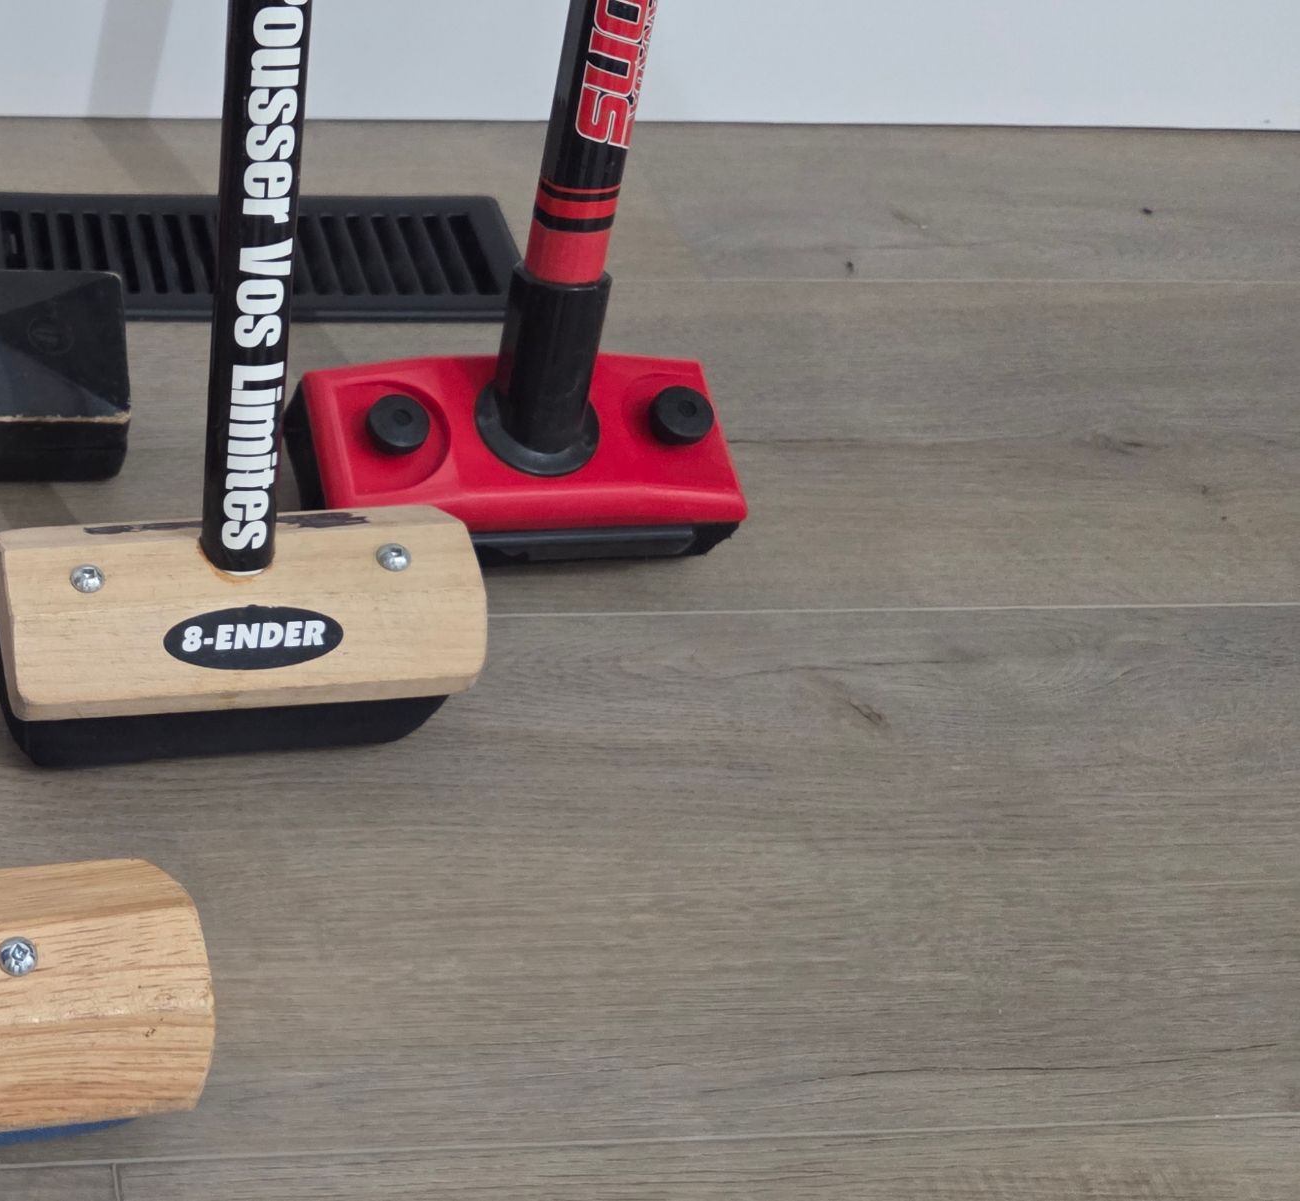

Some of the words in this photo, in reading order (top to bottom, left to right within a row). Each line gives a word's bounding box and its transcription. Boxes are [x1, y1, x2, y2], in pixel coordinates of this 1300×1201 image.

[242, 0, 305, 224] ousser
[233, 237, 293, 349] Vos
[221, 362, 284, 551] Limites
[181, 620, 326, 652] 8-ENDER
